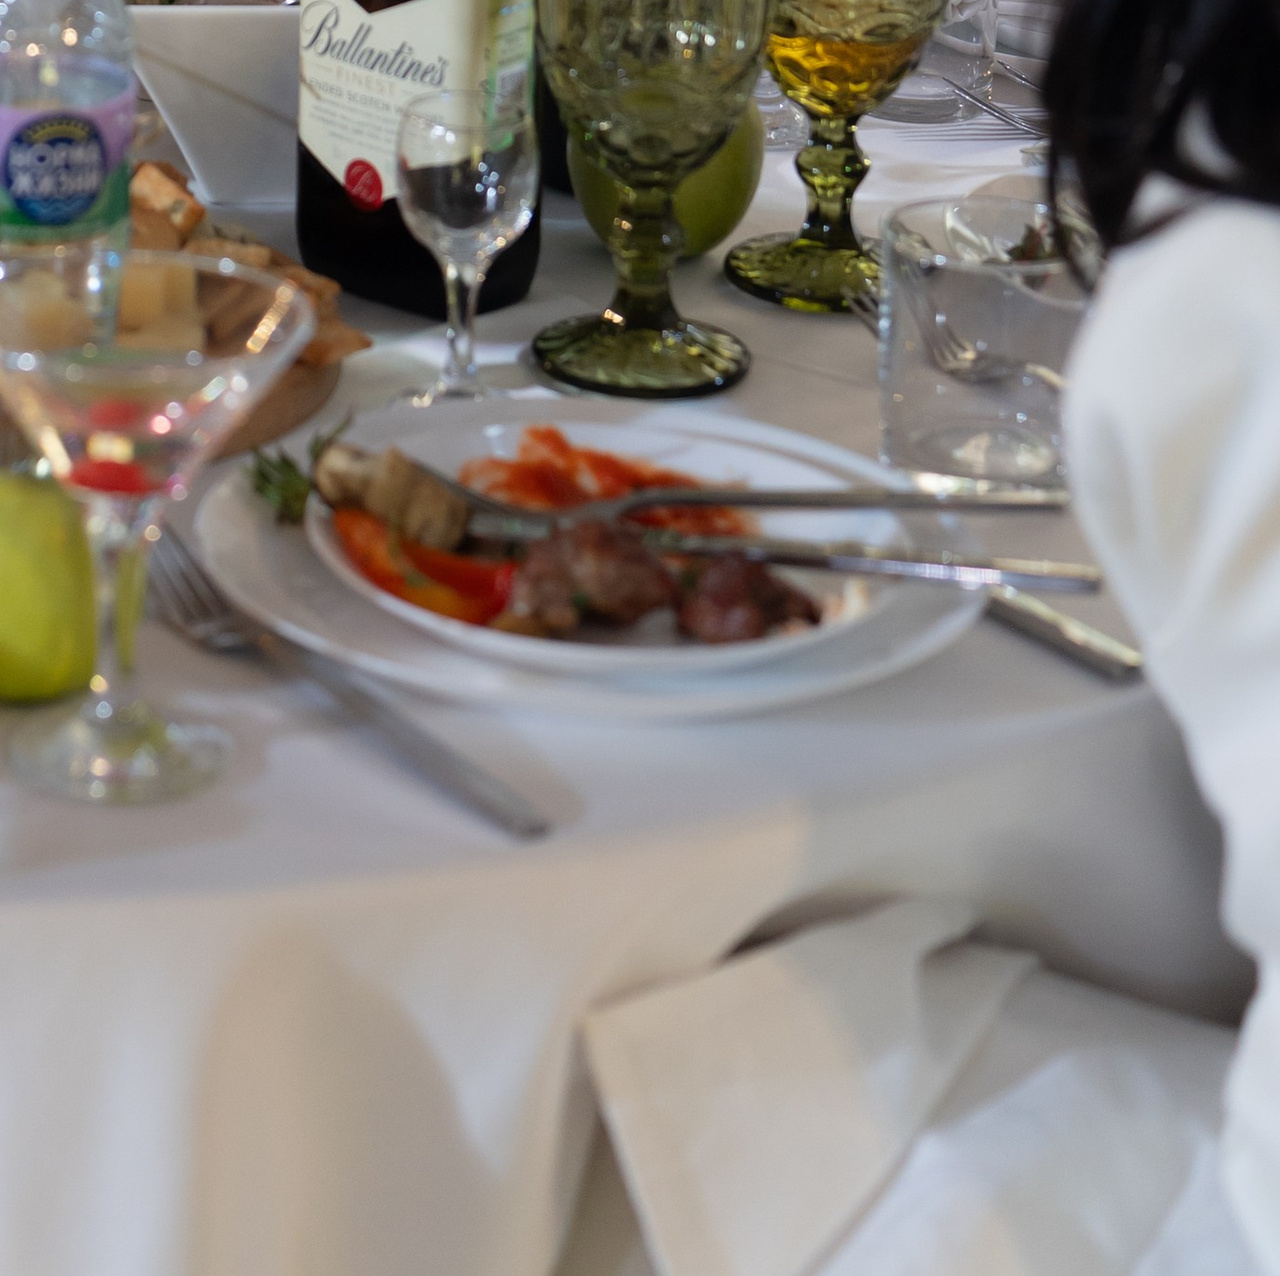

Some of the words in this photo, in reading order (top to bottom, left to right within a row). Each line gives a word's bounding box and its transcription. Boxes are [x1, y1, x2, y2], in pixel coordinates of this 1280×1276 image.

[300, 0, 449, 88] Ballantine's
[335, 65, 396, 95] FINEST
[346, 89, 391, 113] SCOTCH
